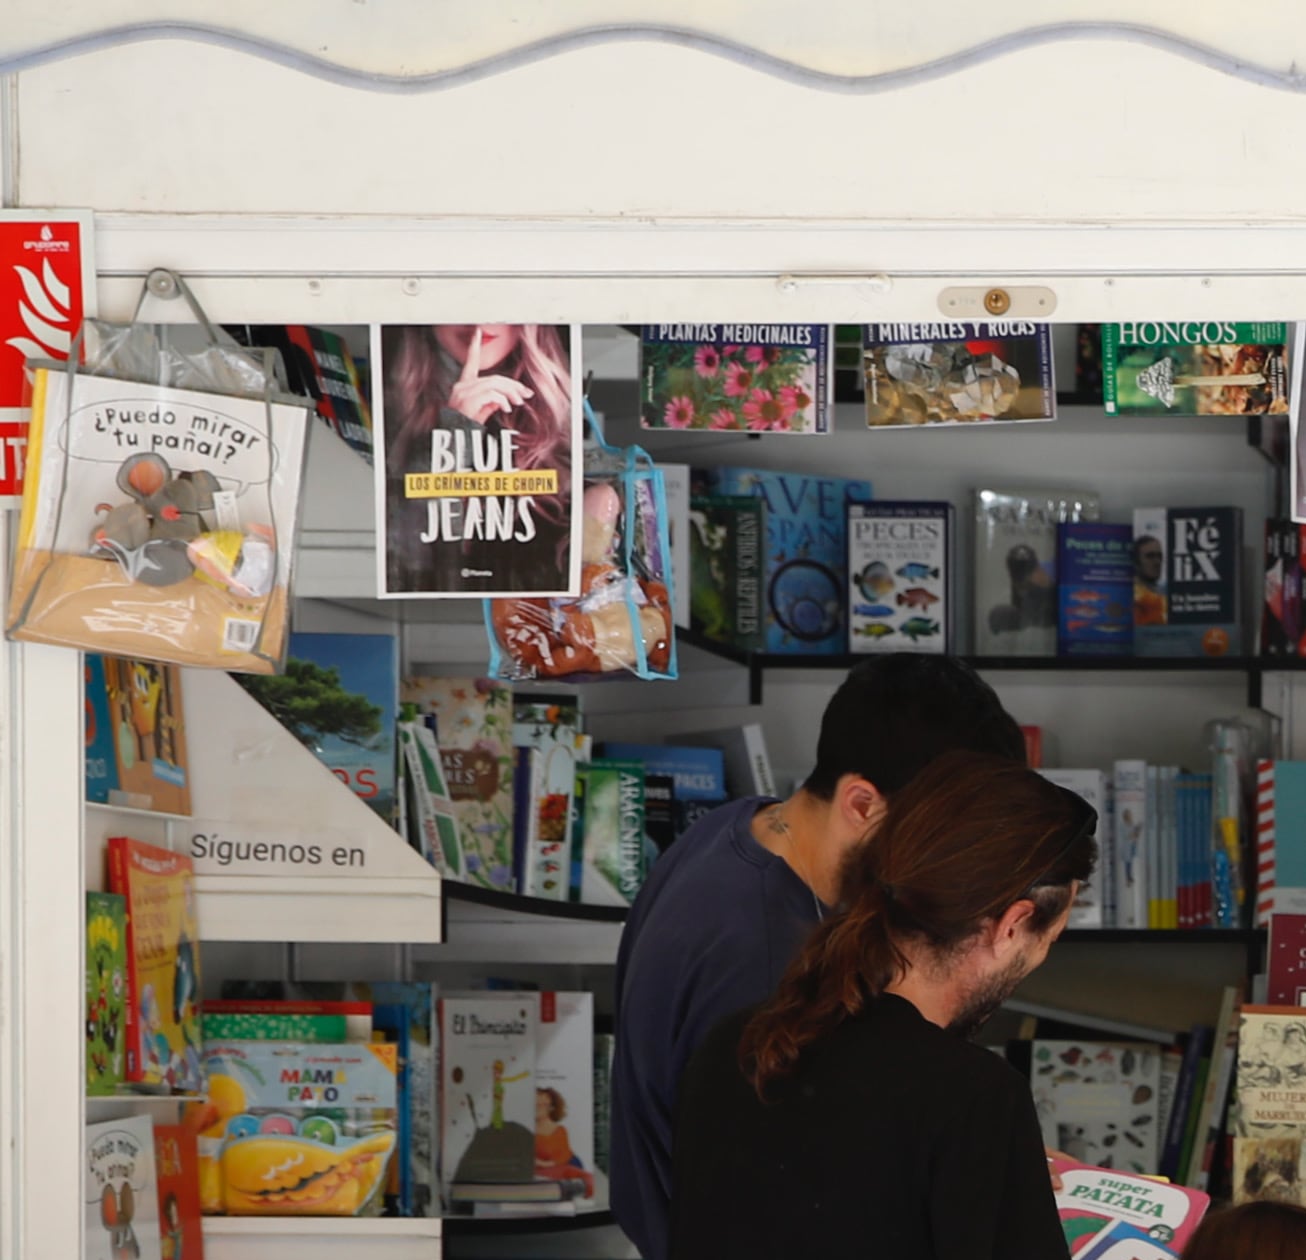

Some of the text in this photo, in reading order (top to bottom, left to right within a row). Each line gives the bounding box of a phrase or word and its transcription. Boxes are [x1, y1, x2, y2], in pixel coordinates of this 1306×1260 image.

[722, 324, 812, 344] MEDICINALES
[94, 406, 259, 450] ¿Puedo mirar
[114, 429, 238, 465] tu pañal?
[431, 429, 520, 473] BLUE
[409, 474, 554, 493] LOS CRÍMENES DE CHOPIN
[420, 496, 537, 543] JEANS
[855, 521, 939, 542] PECES
[190, 833, 365, 867] Síguenos en
[452, 1014, 527, 1040] El Principito
[1068, 1183, 1164, 1220] PATATA
[1098, 1177, 1152, 1198] super
